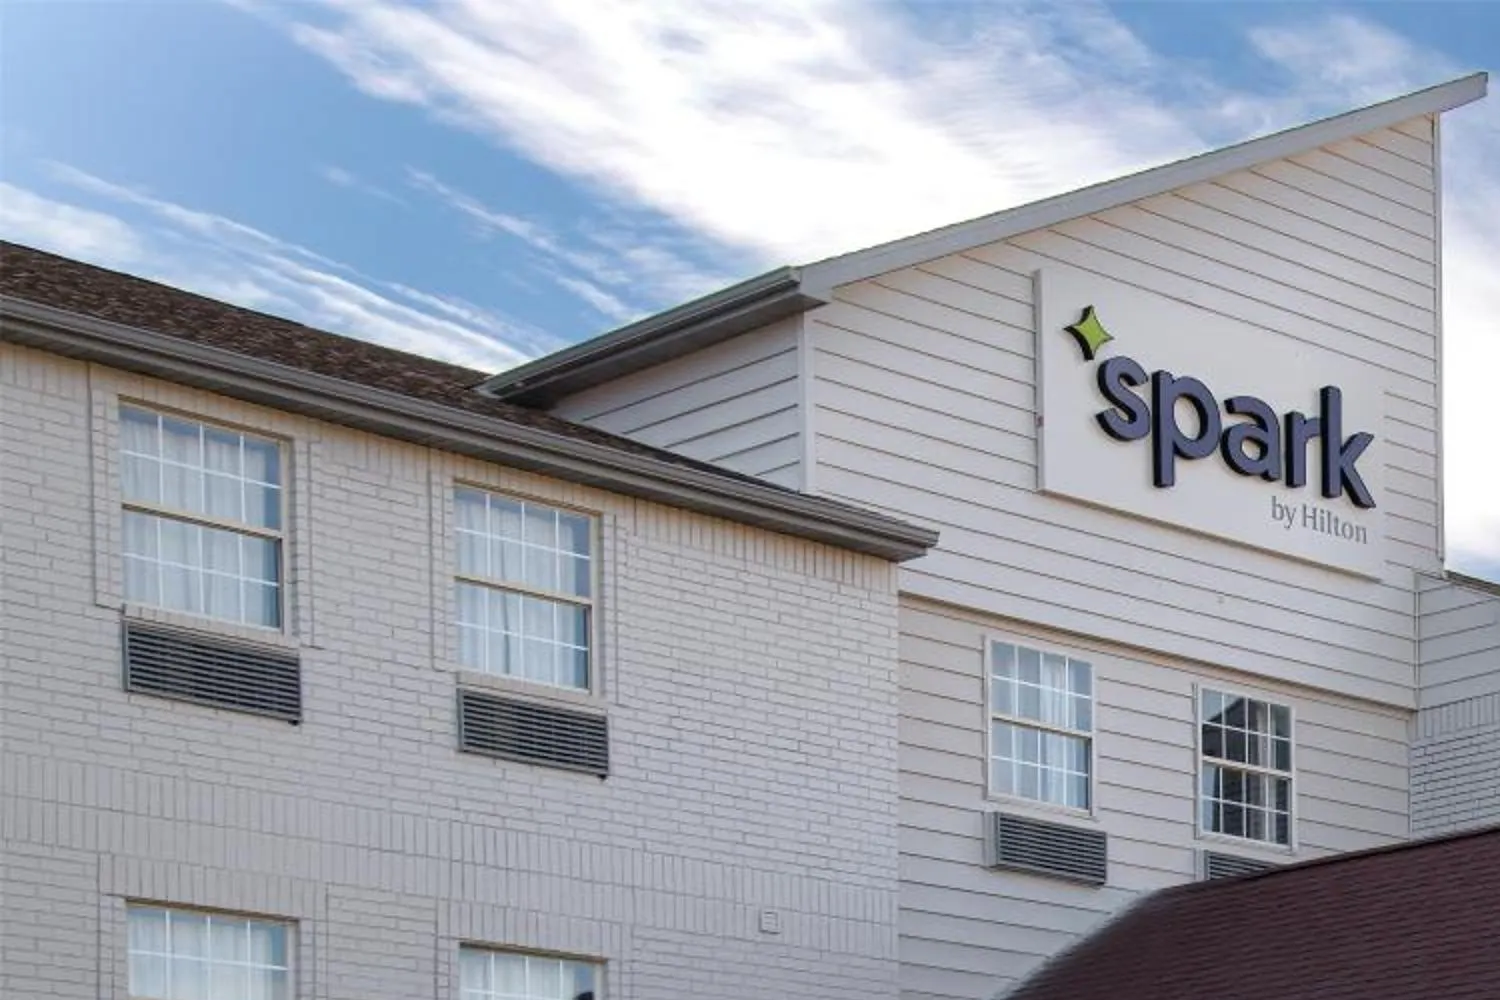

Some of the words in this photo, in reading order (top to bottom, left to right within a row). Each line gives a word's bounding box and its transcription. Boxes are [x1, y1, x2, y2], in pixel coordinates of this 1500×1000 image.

[1096, 355, 1376, 508] spark
[1271, 496, 1296, 528] by
[1302, 506, 1368, 545] Hilton
